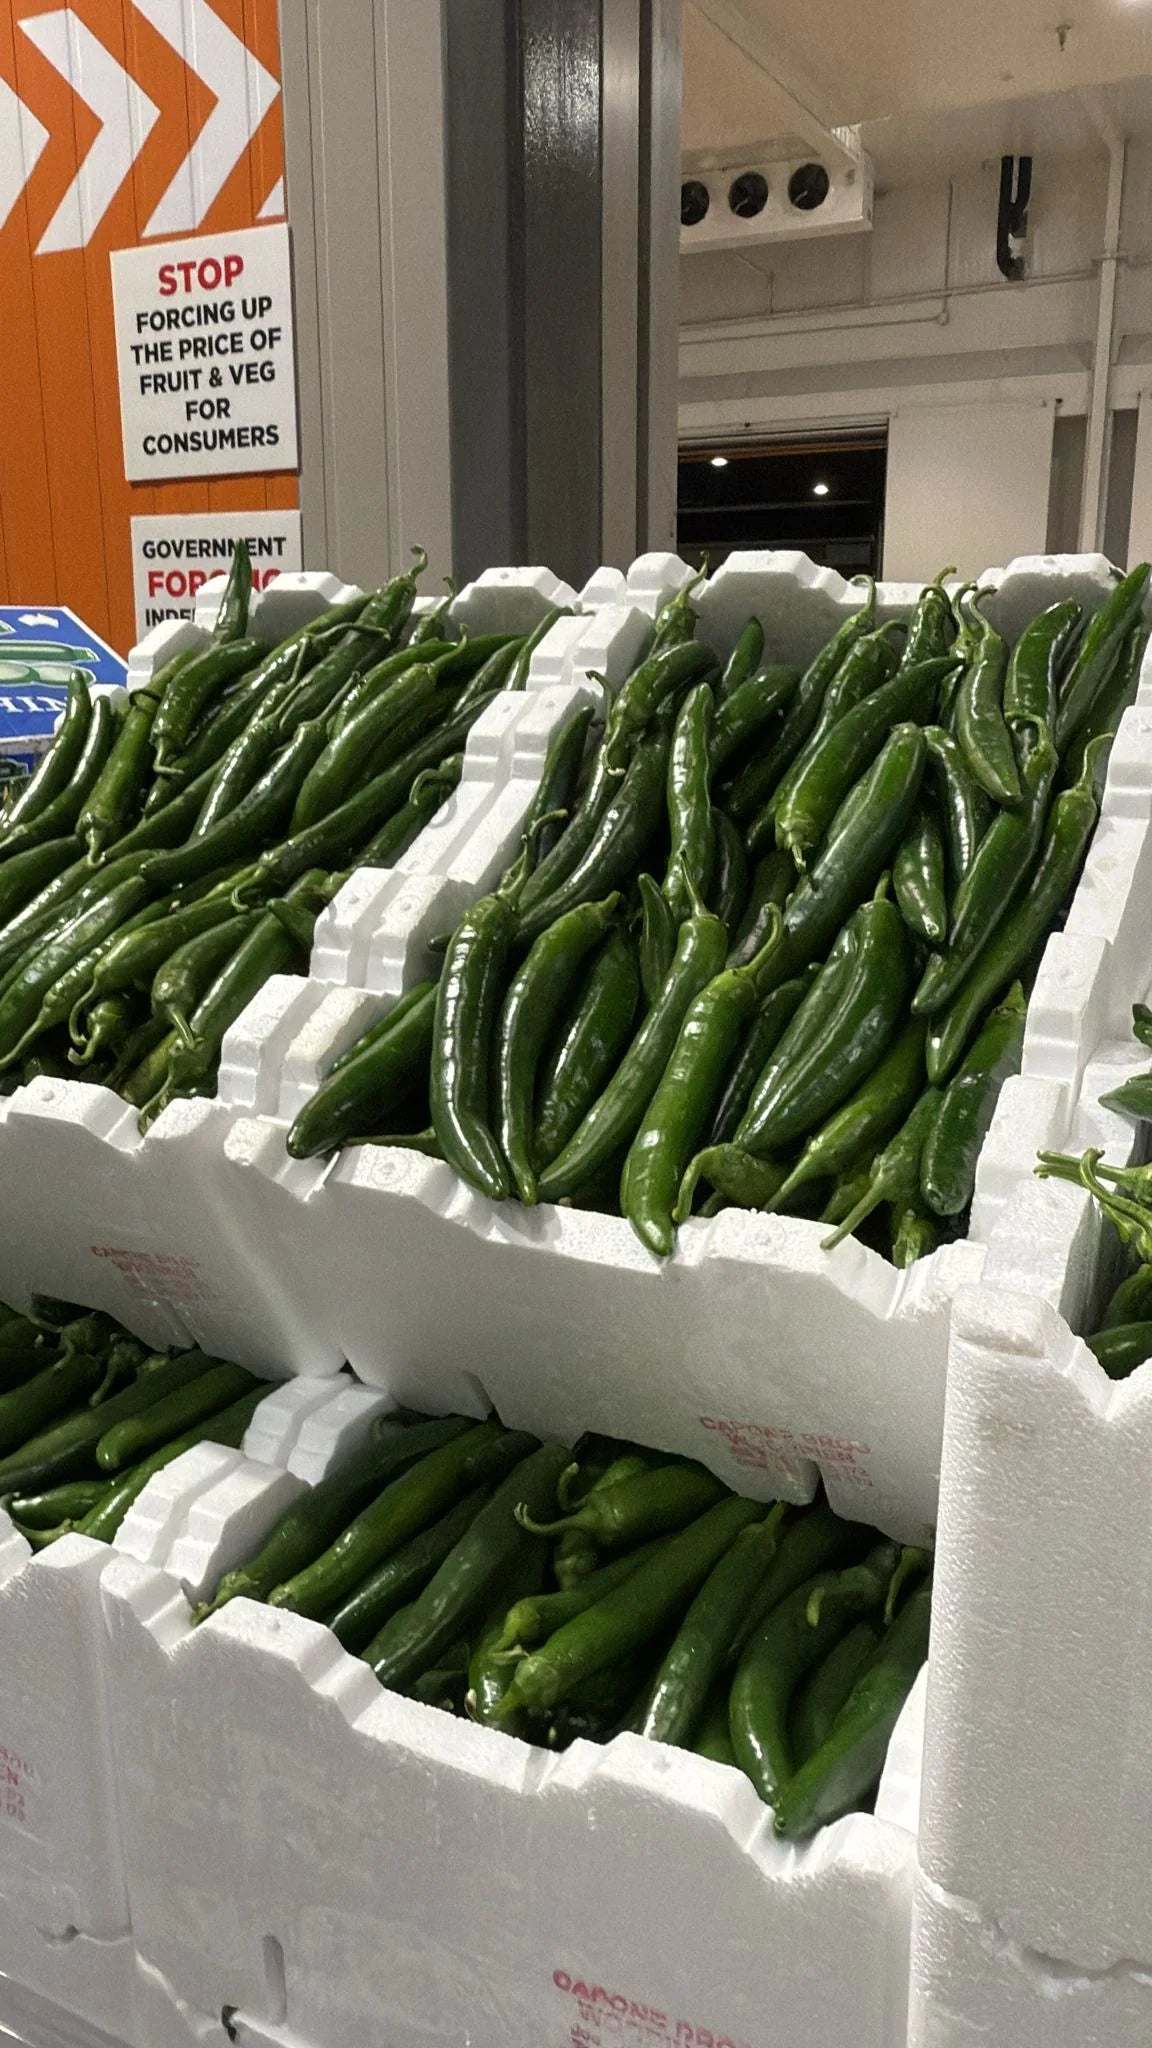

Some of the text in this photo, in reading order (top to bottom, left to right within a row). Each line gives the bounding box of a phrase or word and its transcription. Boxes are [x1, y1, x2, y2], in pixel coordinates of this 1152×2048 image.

[158, 254, 244, 296] STOP
[136, 296, 272, 334] FORCING UP
[130, 327, 282, 365] THE PRICE OF
[140, 361, 276, 395] FRUIT & VEG
[185, 397, 231, 421] FOR
[143, 425, 280, 456] CONSUMERS
